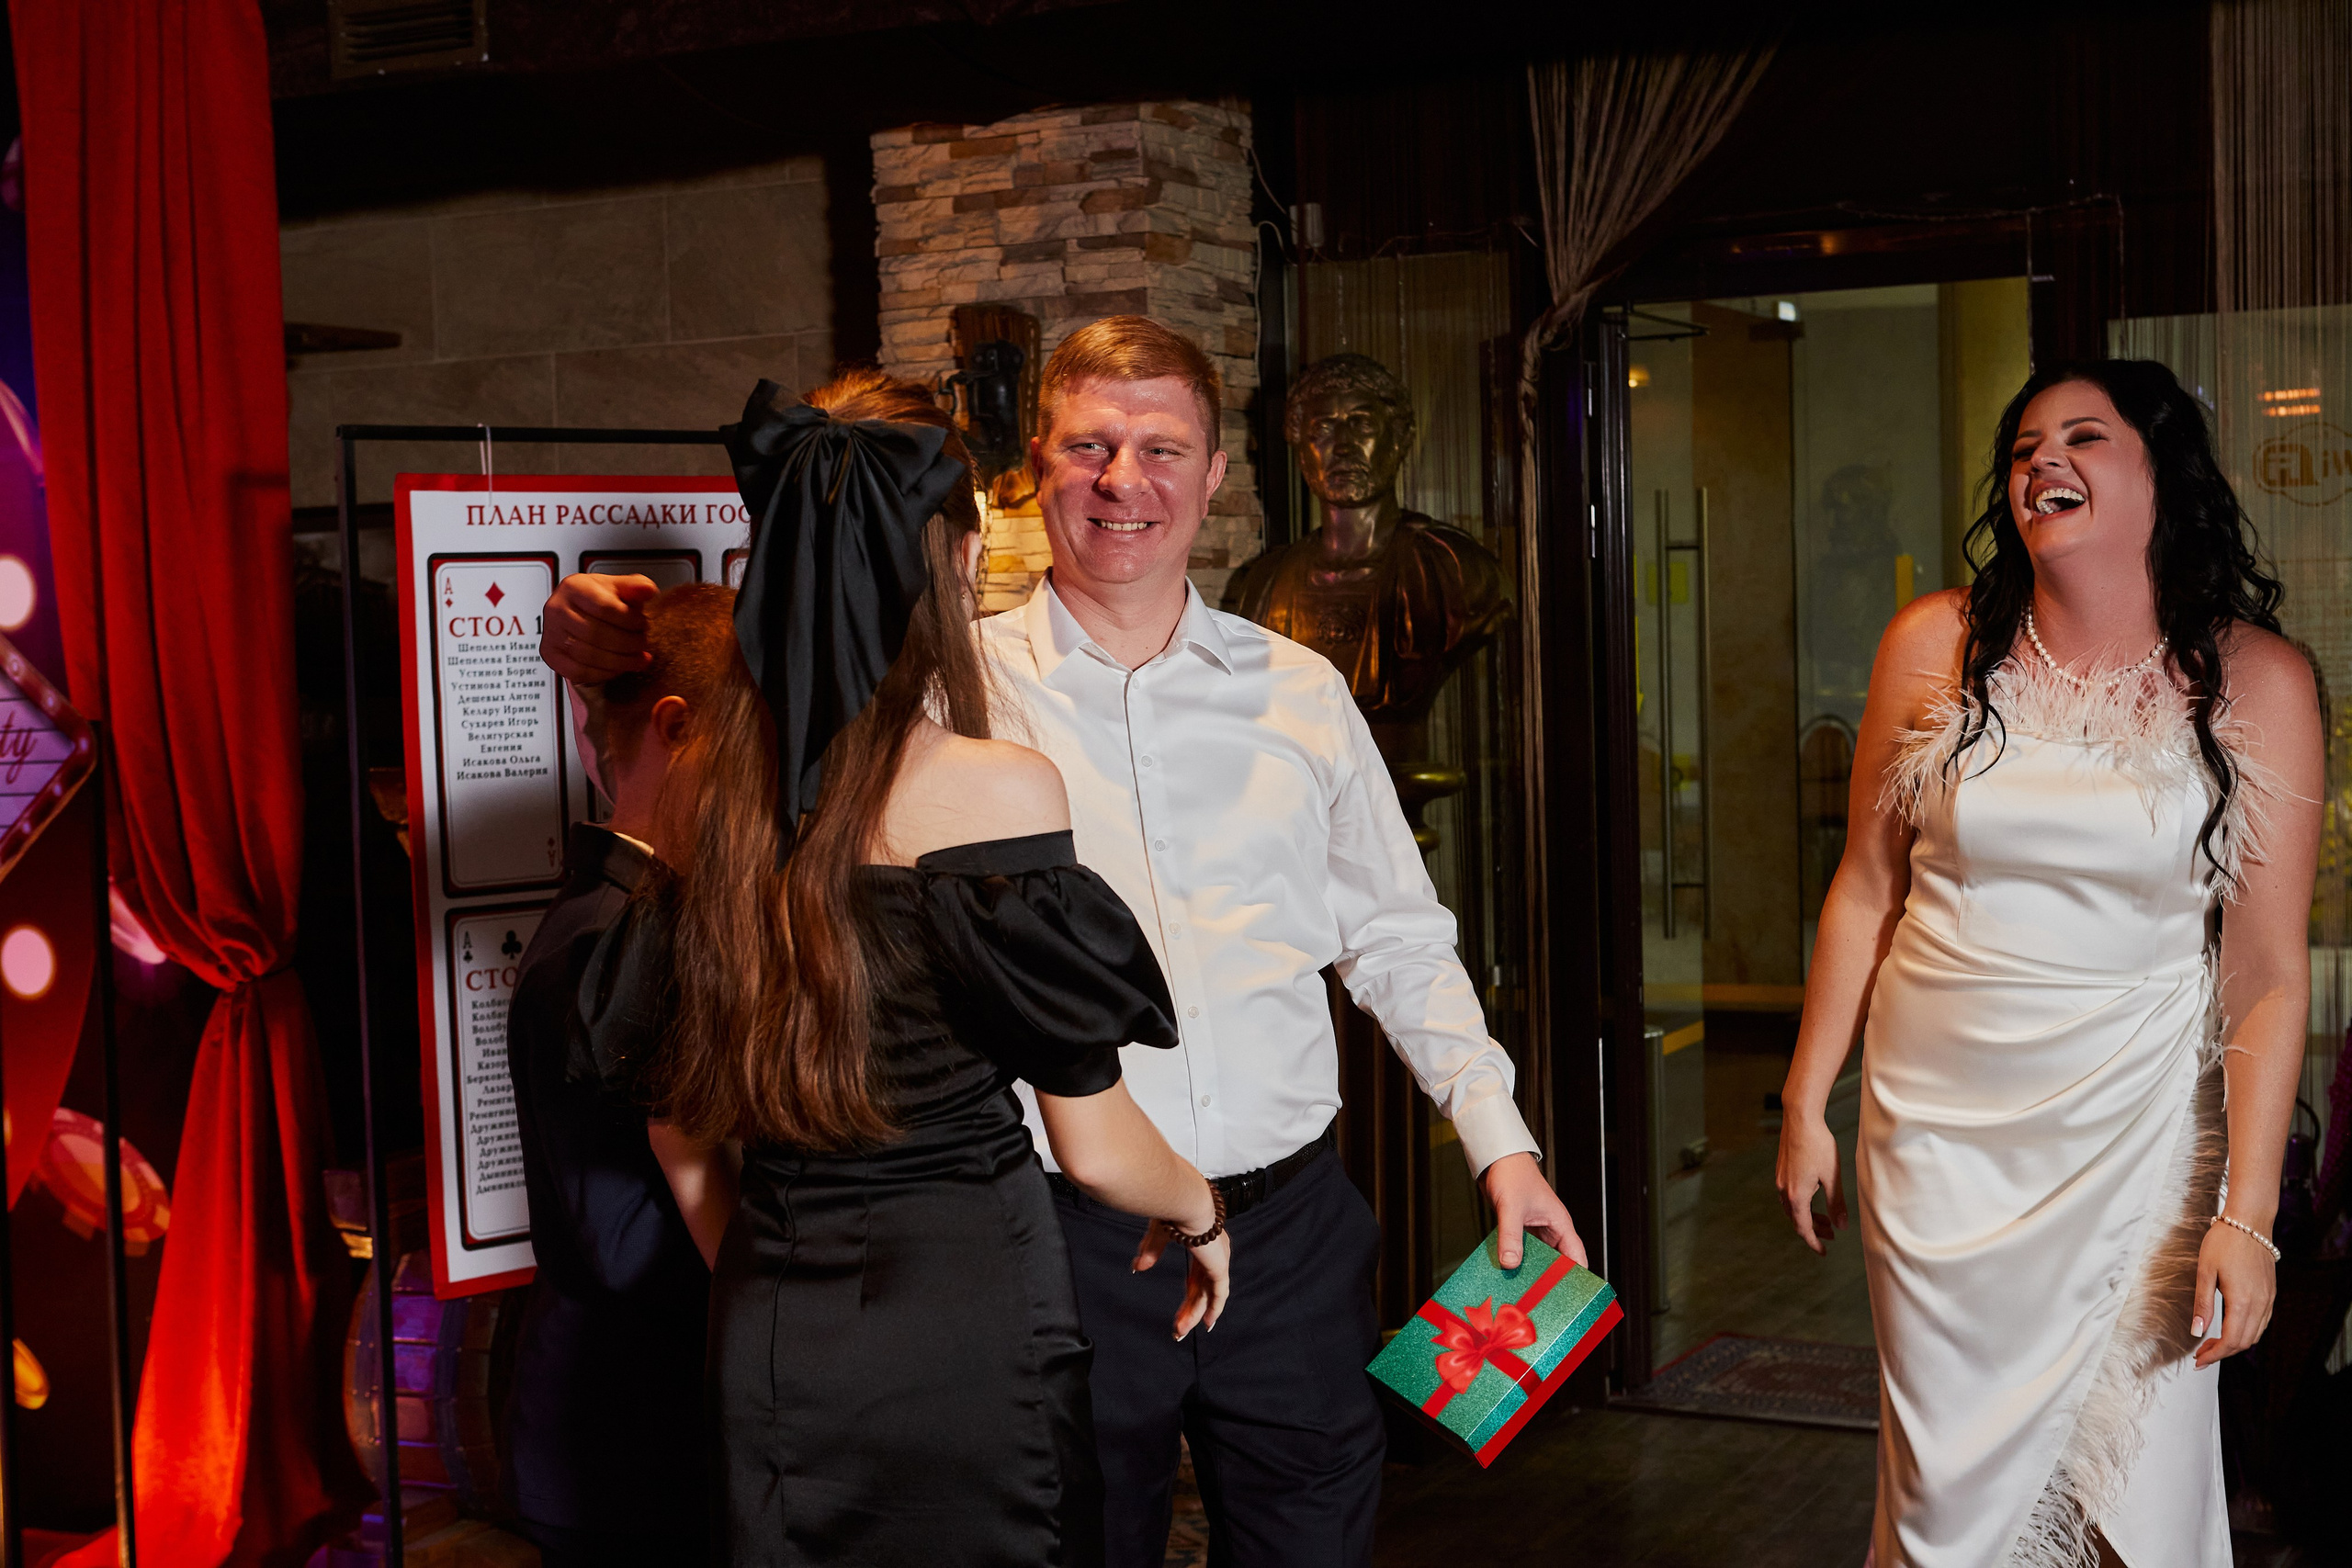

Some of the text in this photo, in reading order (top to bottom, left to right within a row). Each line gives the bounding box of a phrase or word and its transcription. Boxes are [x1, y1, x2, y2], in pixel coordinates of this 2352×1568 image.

[466, 505, 546, 525] ПЛАН
[556, 504, 696, 529] РАССАДКИ
[449, 615, 525, 637] СТОЛ
[458, 641, 537, 653] Шепелев Иван
[447, 654, 542, 666] Шепелева Евгени
[458, 667, 537, 678] Устинов Борис
[451, 679, 546, 691] Устинова Татьяна
[458, 692, 540, 705] Дешевых Антон
[503, 705, 537, 715] Ирина
[461, 717, 539, 730] Сухарев Игорь
[481, 743, 523, 753] Евгения
[462, 755, 540, 768] Исакова Ольга
[457, 768, 548, 781] Исакова Валерия
